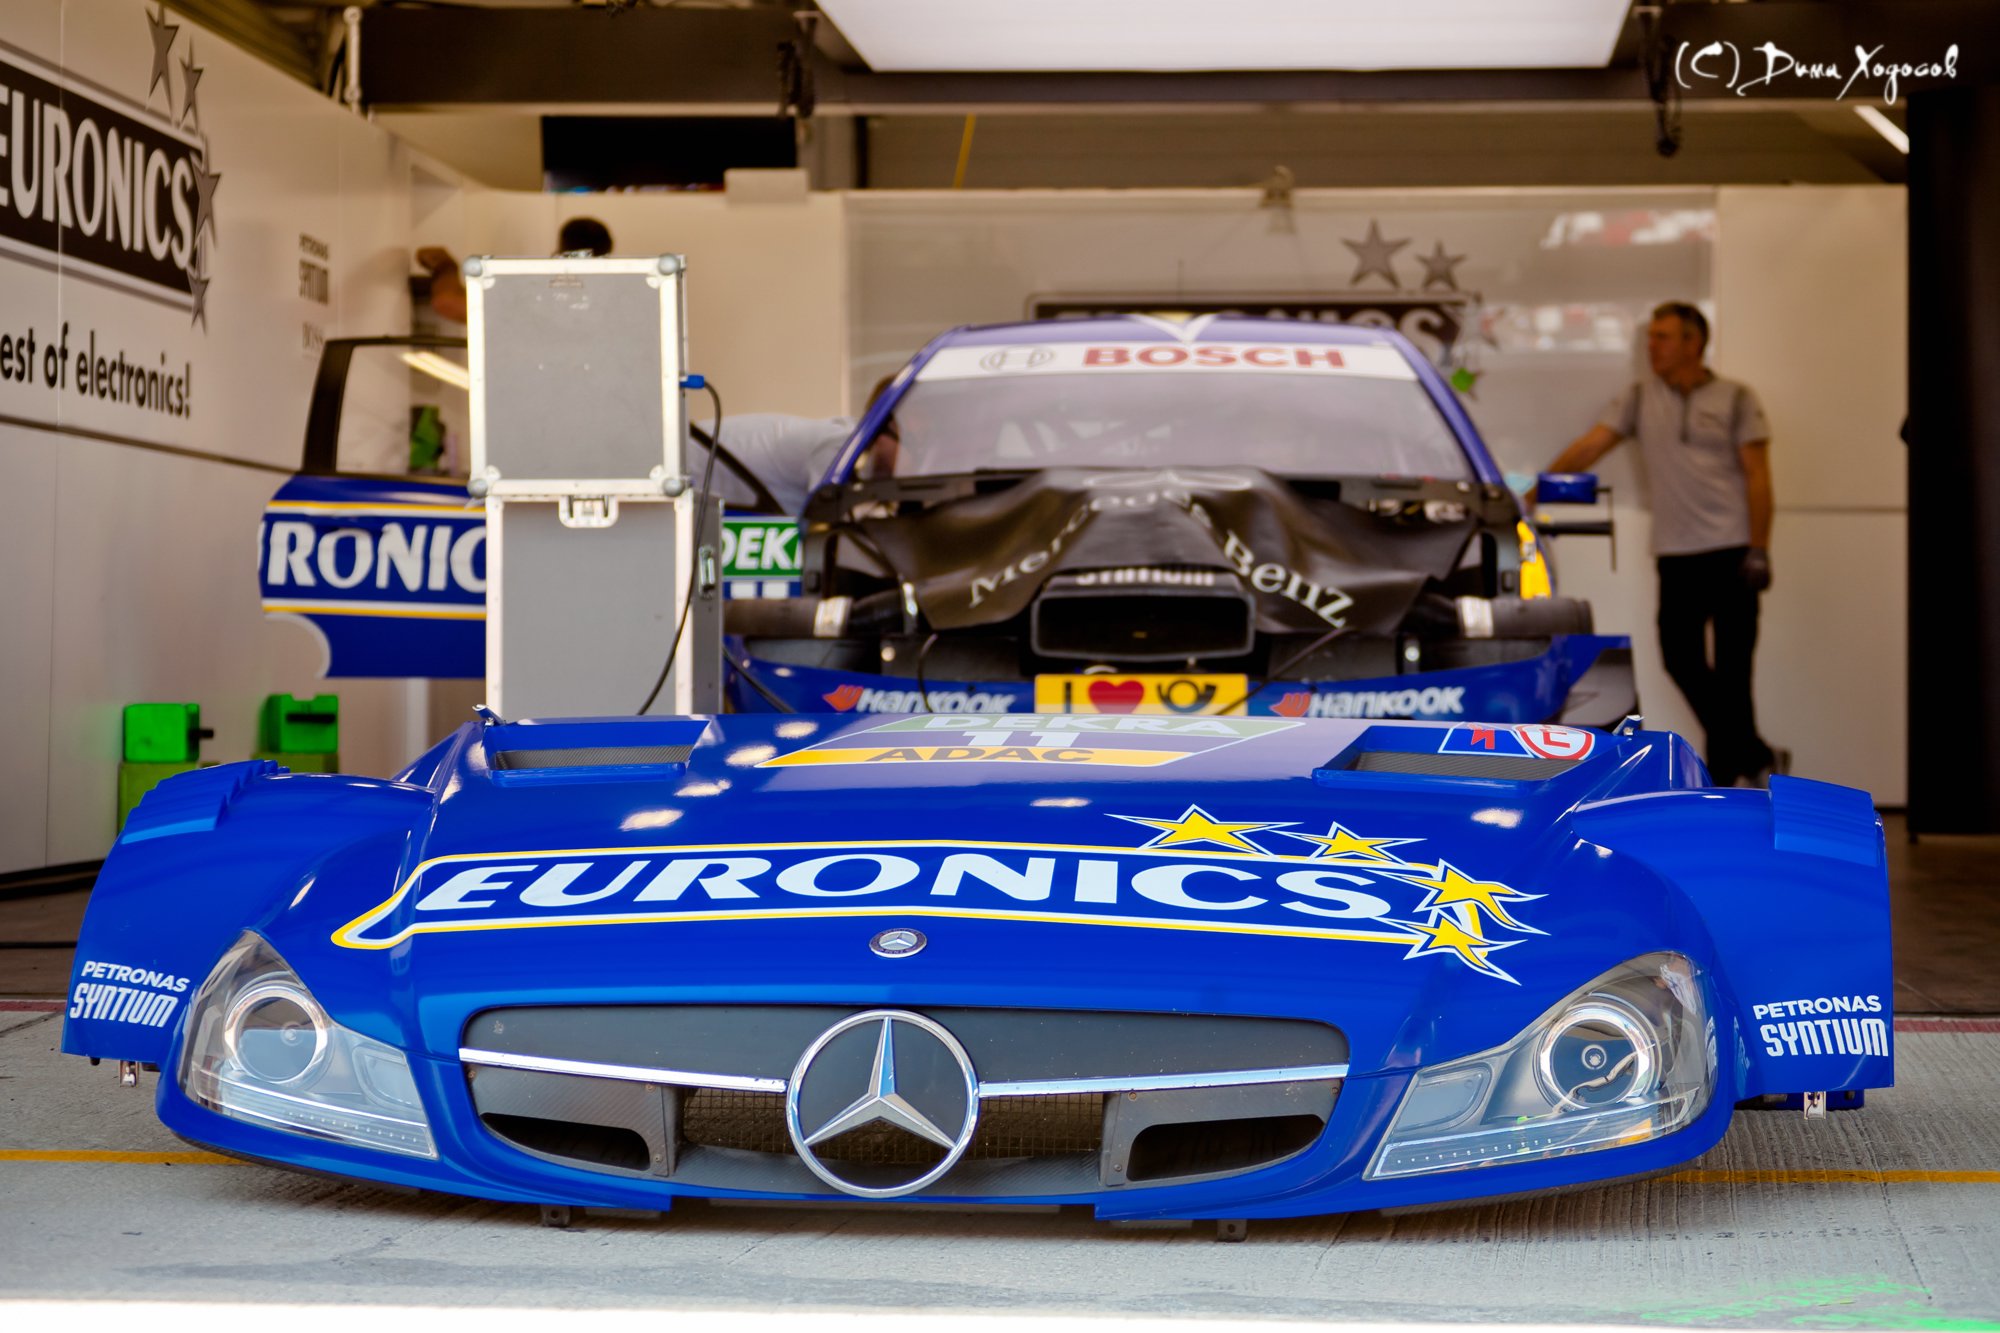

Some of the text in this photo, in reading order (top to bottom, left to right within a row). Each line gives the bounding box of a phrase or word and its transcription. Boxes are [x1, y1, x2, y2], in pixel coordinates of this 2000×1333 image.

[43, 321, 69, 390] of
[75, 329, 191, 419] electronics!
[1083, 347, 1346, 368] BOSCH
[257, 520, 486, 593] RONIC
[1223, 530, 1353, 629] Benz
[924, 715, 1240, 736] DEKRA
[962, 730, 1081, 747] 11
[864, 747, 1095, 763] ADAC
[415, 853, 1391, 919] EURONICS
[80, 960, 191, 993] PETRONAS
[69, 982, 179, 1028] SYNTIUM
[1752, 994, 1882, 1020] PETRONAS
[1759, 1018, 1889, 1057] SYNTIUM
